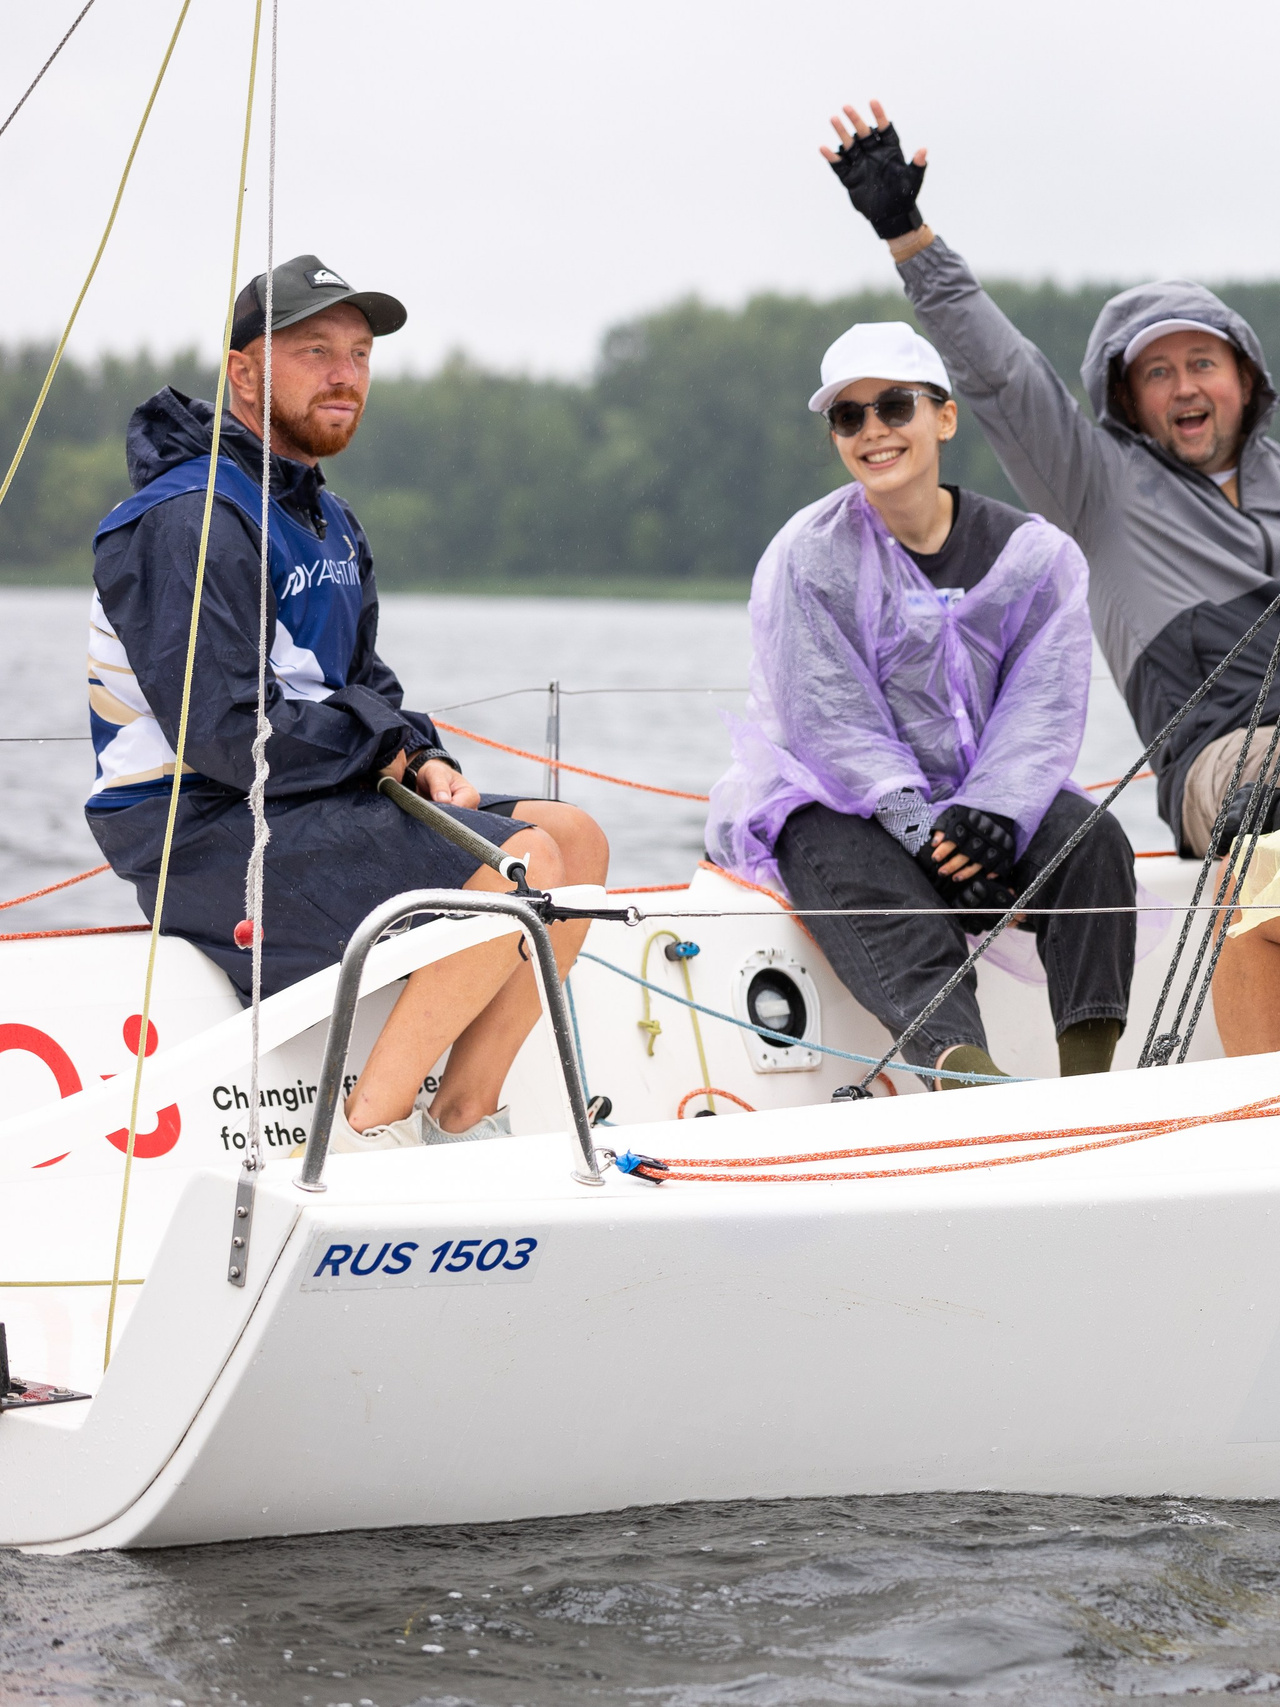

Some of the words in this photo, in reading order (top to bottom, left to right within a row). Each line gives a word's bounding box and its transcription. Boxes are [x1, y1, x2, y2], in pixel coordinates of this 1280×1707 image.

[213, 1079, 318, 1112] Chngin
[220, 1126, 251, 1150] fo
[264, 1122, 307, 1147] the
[313, 1241, 419, 1278] RUS
[429, 1237, 538, 1274] 1503
